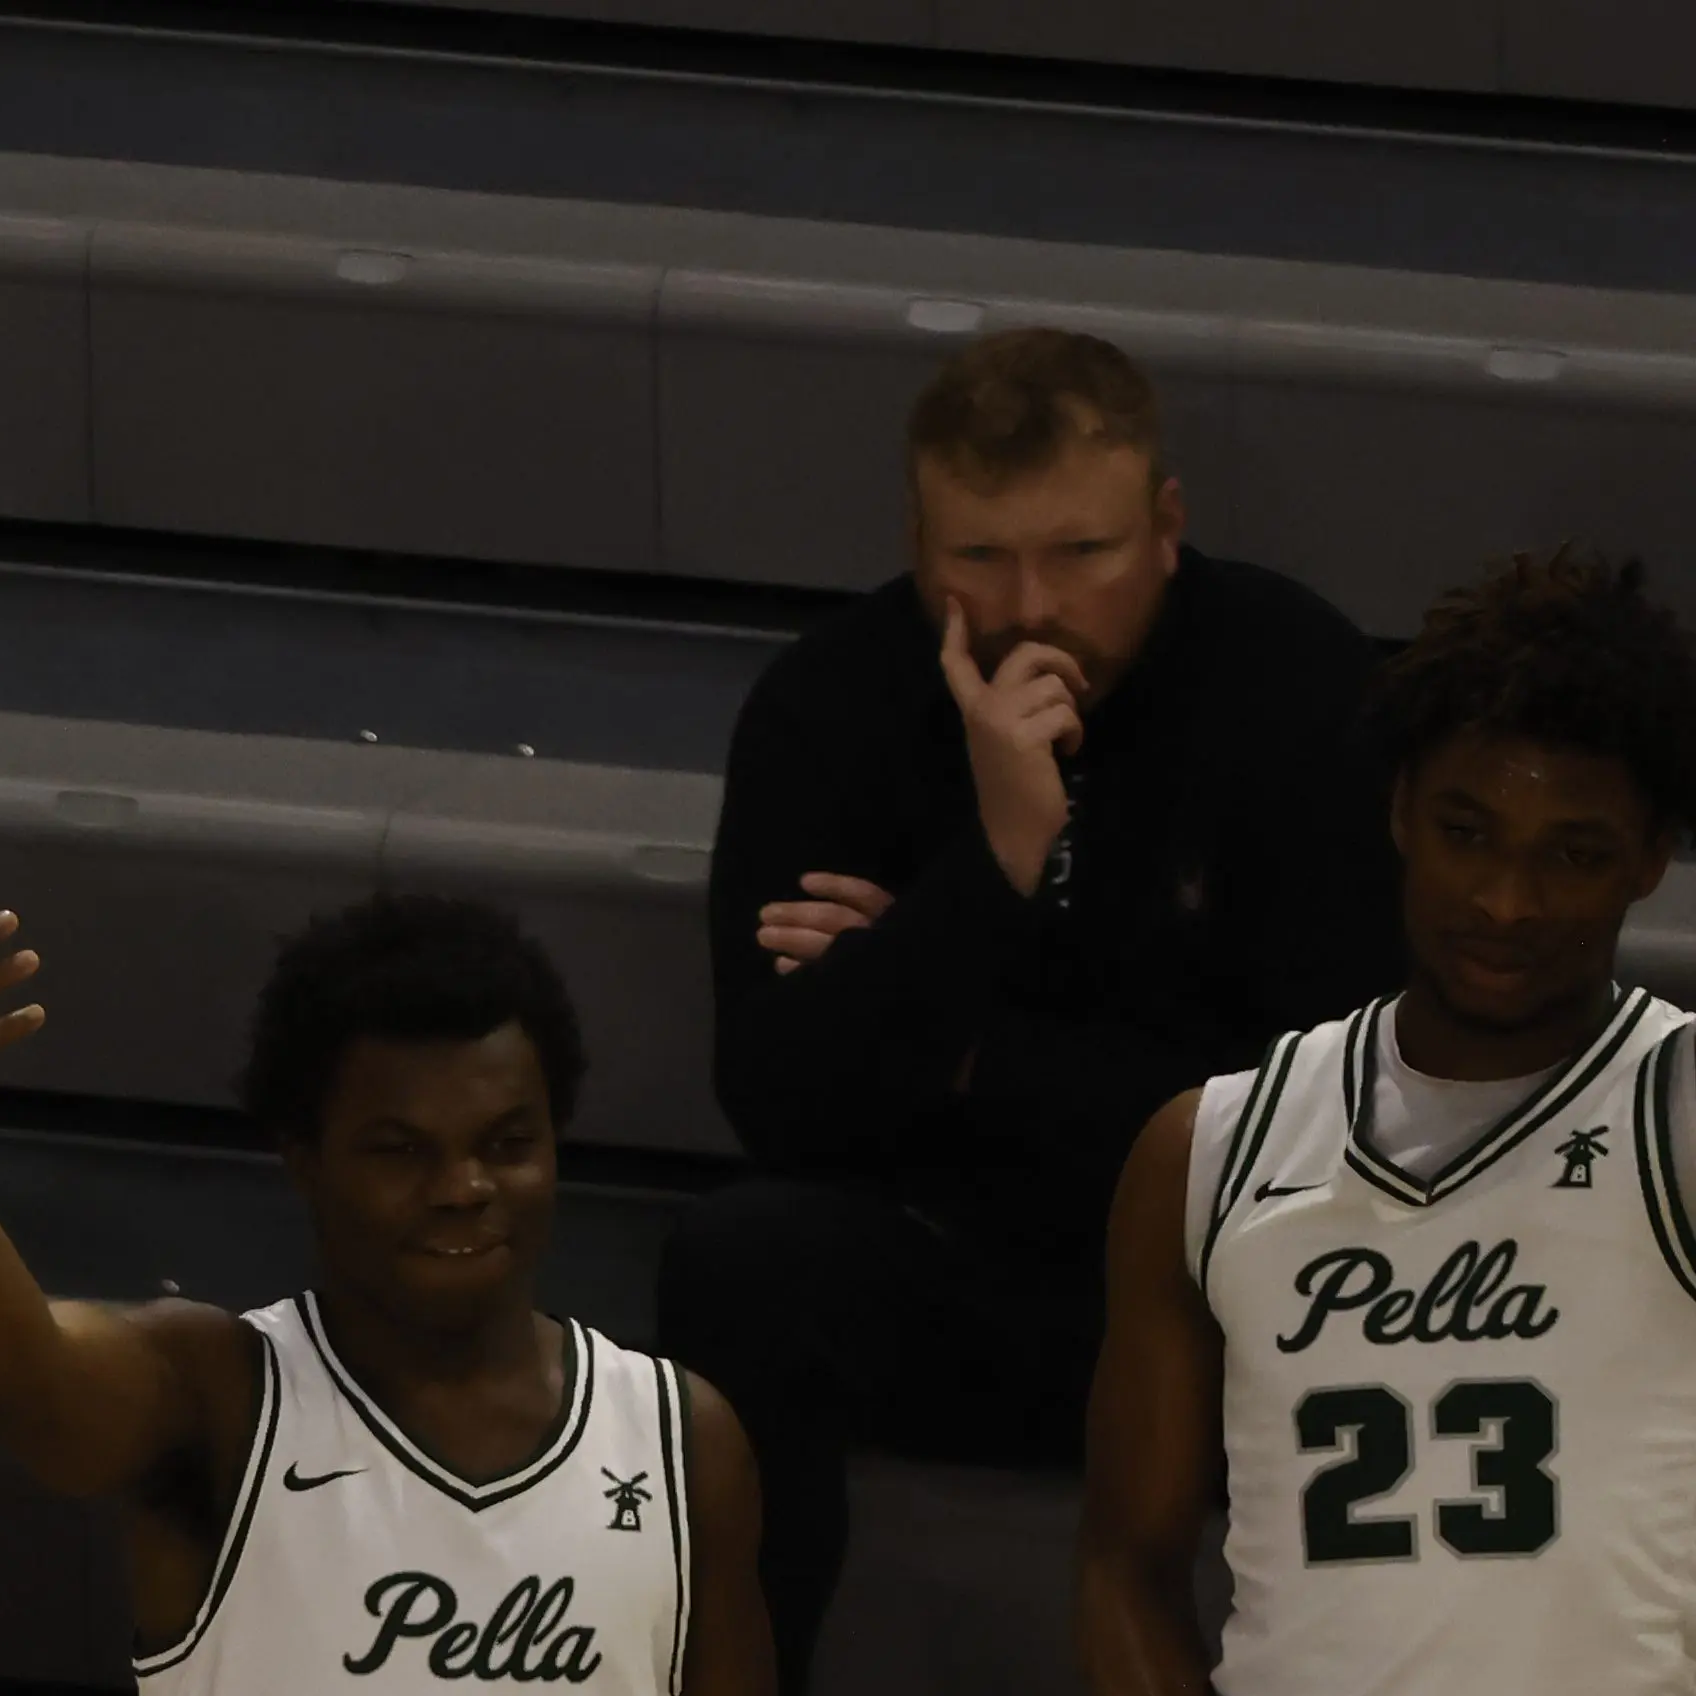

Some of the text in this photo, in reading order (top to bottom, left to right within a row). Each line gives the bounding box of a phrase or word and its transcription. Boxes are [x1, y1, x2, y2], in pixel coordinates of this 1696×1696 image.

[1275, 1238, 1559, 1354] Pella
[1292, 1378, 1559, 1567] 23
[342, 1571, 603, 1684] Pella
